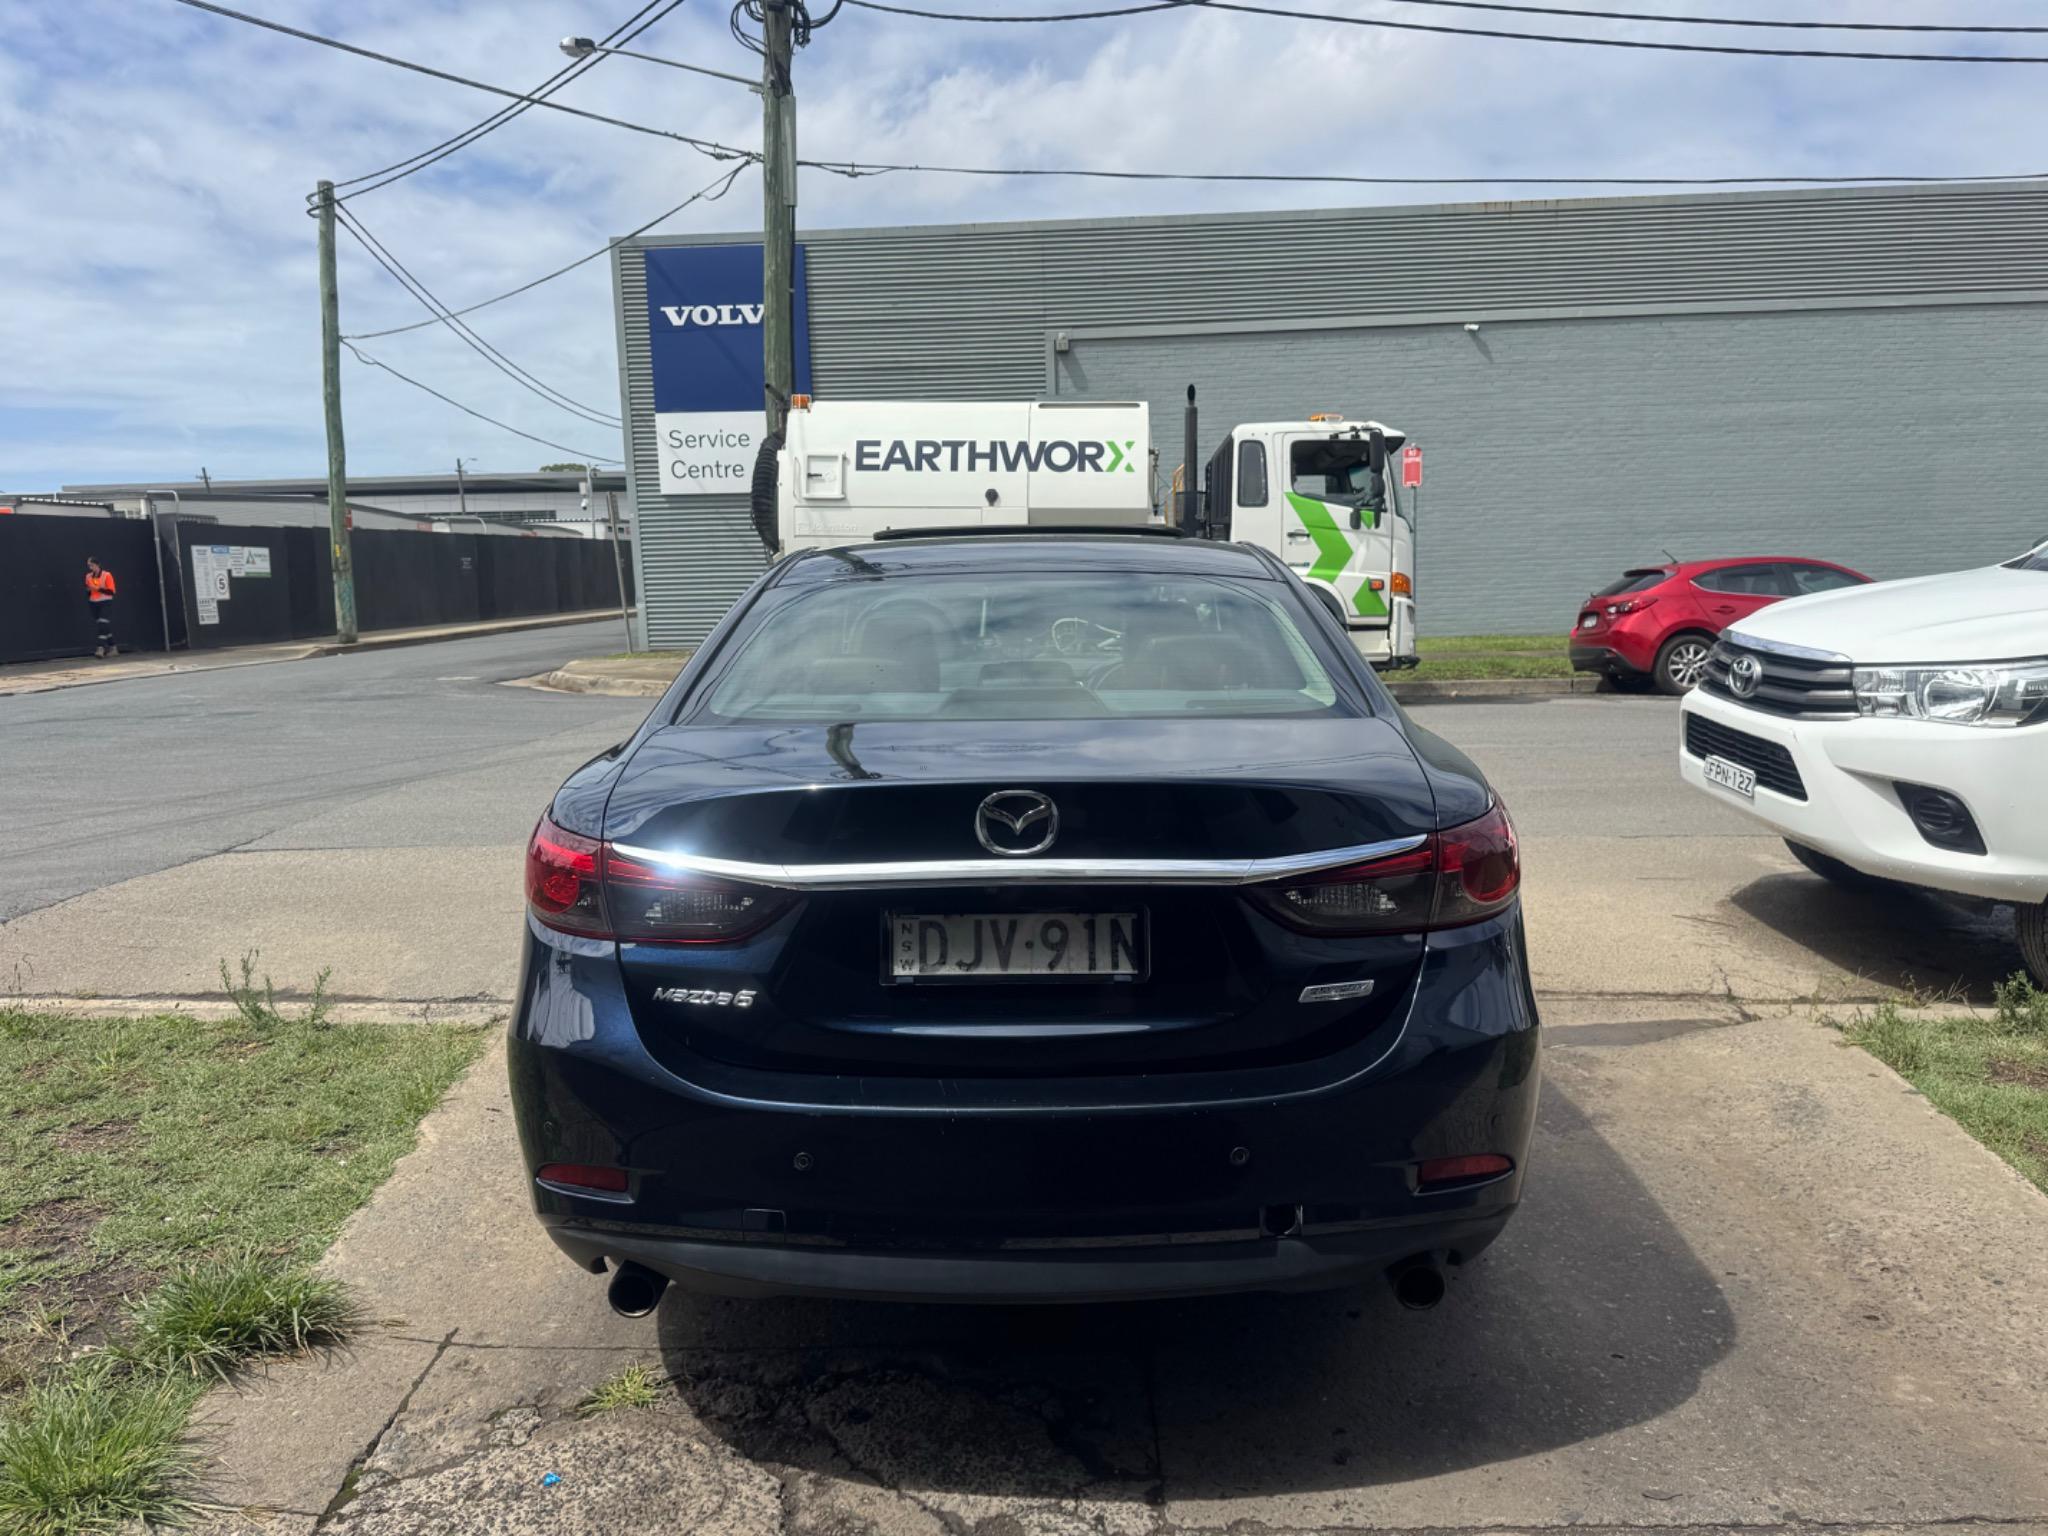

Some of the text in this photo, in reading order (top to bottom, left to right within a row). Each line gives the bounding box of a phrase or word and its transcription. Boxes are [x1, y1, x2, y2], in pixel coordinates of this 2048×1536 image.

[660, 304, 764, 326] VOLV
[669, 429, 751, 449] Service
[855, 440, 1136, 472] EARTHWORX
[671, 460, 744, 479] Centre
